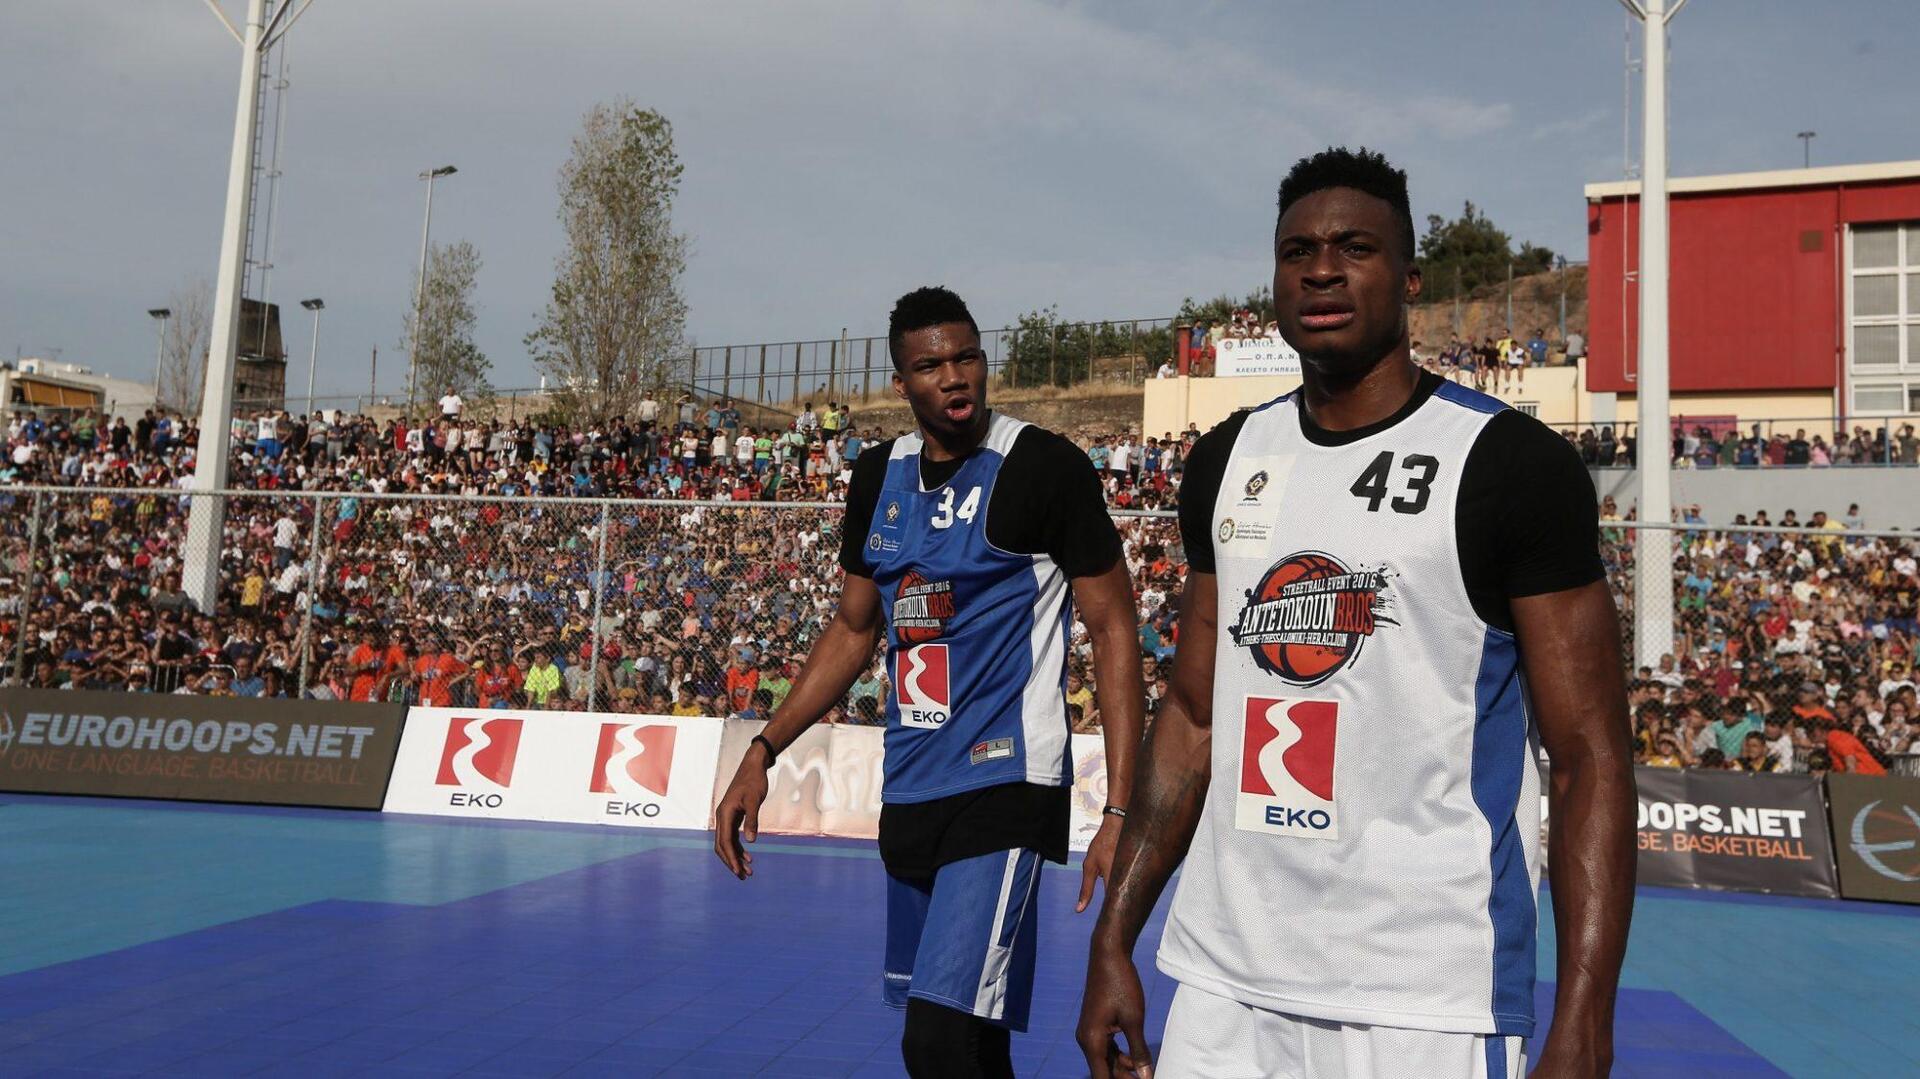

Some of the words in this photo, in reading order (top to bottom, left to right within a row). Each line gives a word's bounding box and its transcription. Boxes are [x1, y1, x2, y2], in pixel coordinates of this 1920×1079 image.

[1349, 450, 1440, 515] 43
[931, 486, 983, 529] 34
[1282, 578, 1327, 597] STREETBALL
[1327, 574, 1351, 591] EVENT
[1352, 572, 1378, 588] 2016
[1239, 592, 1378, 636] ANTETOKOUNBROS
[912, 710, 947, 724] EKO
[18, 712, 375, 759] EUROHOOPS.NET
[10, 748, 63, 770] ONE
[207, 757, 365, 786] BASKETBALL
[450, 793, 503, 808] EKO
[605, 801, 660, 818] EKO
[1265, 805, 1331, 830] EKO
[1672, 832, 1812, 860] BASKETBALL
